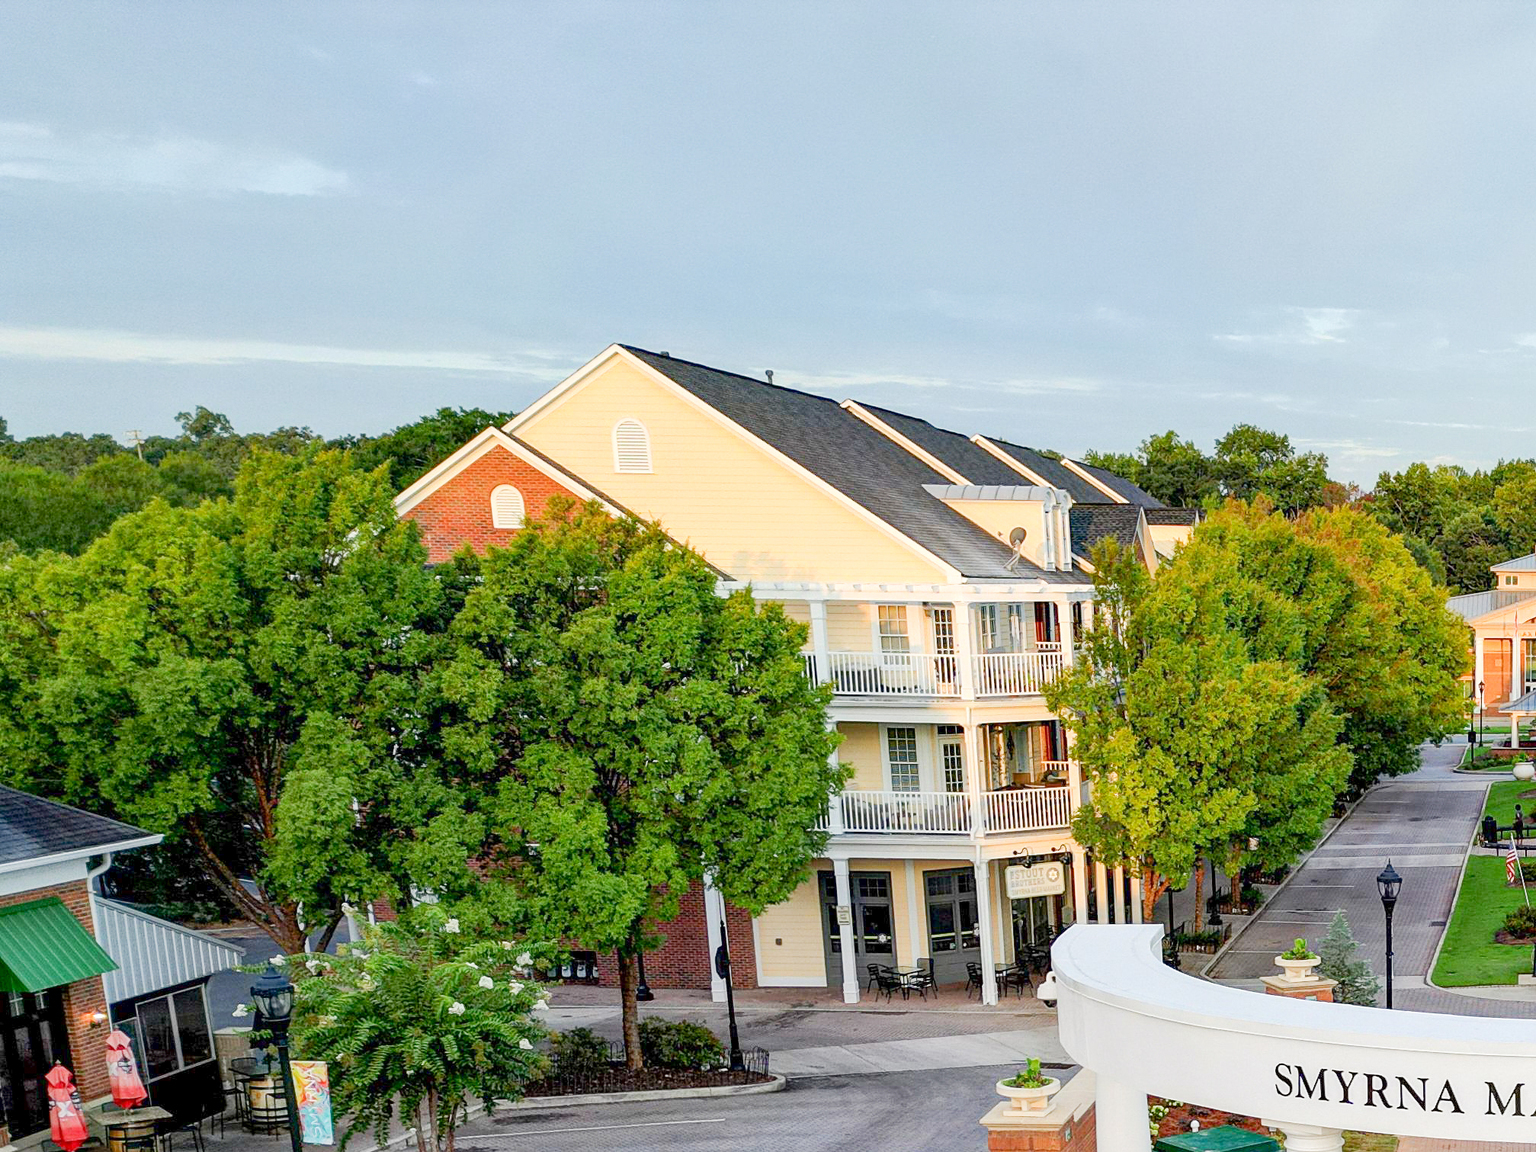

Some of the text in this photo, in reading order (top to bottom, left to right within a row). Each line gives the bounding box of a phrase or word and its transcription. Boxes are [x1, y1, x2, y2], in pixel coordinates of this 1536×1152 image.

[1015, 868, 1044, 879] STOUT
[304, 1069, 322, 1138] SMYRNA
[1275, 1063, 1465, 1114] SMYRNA
